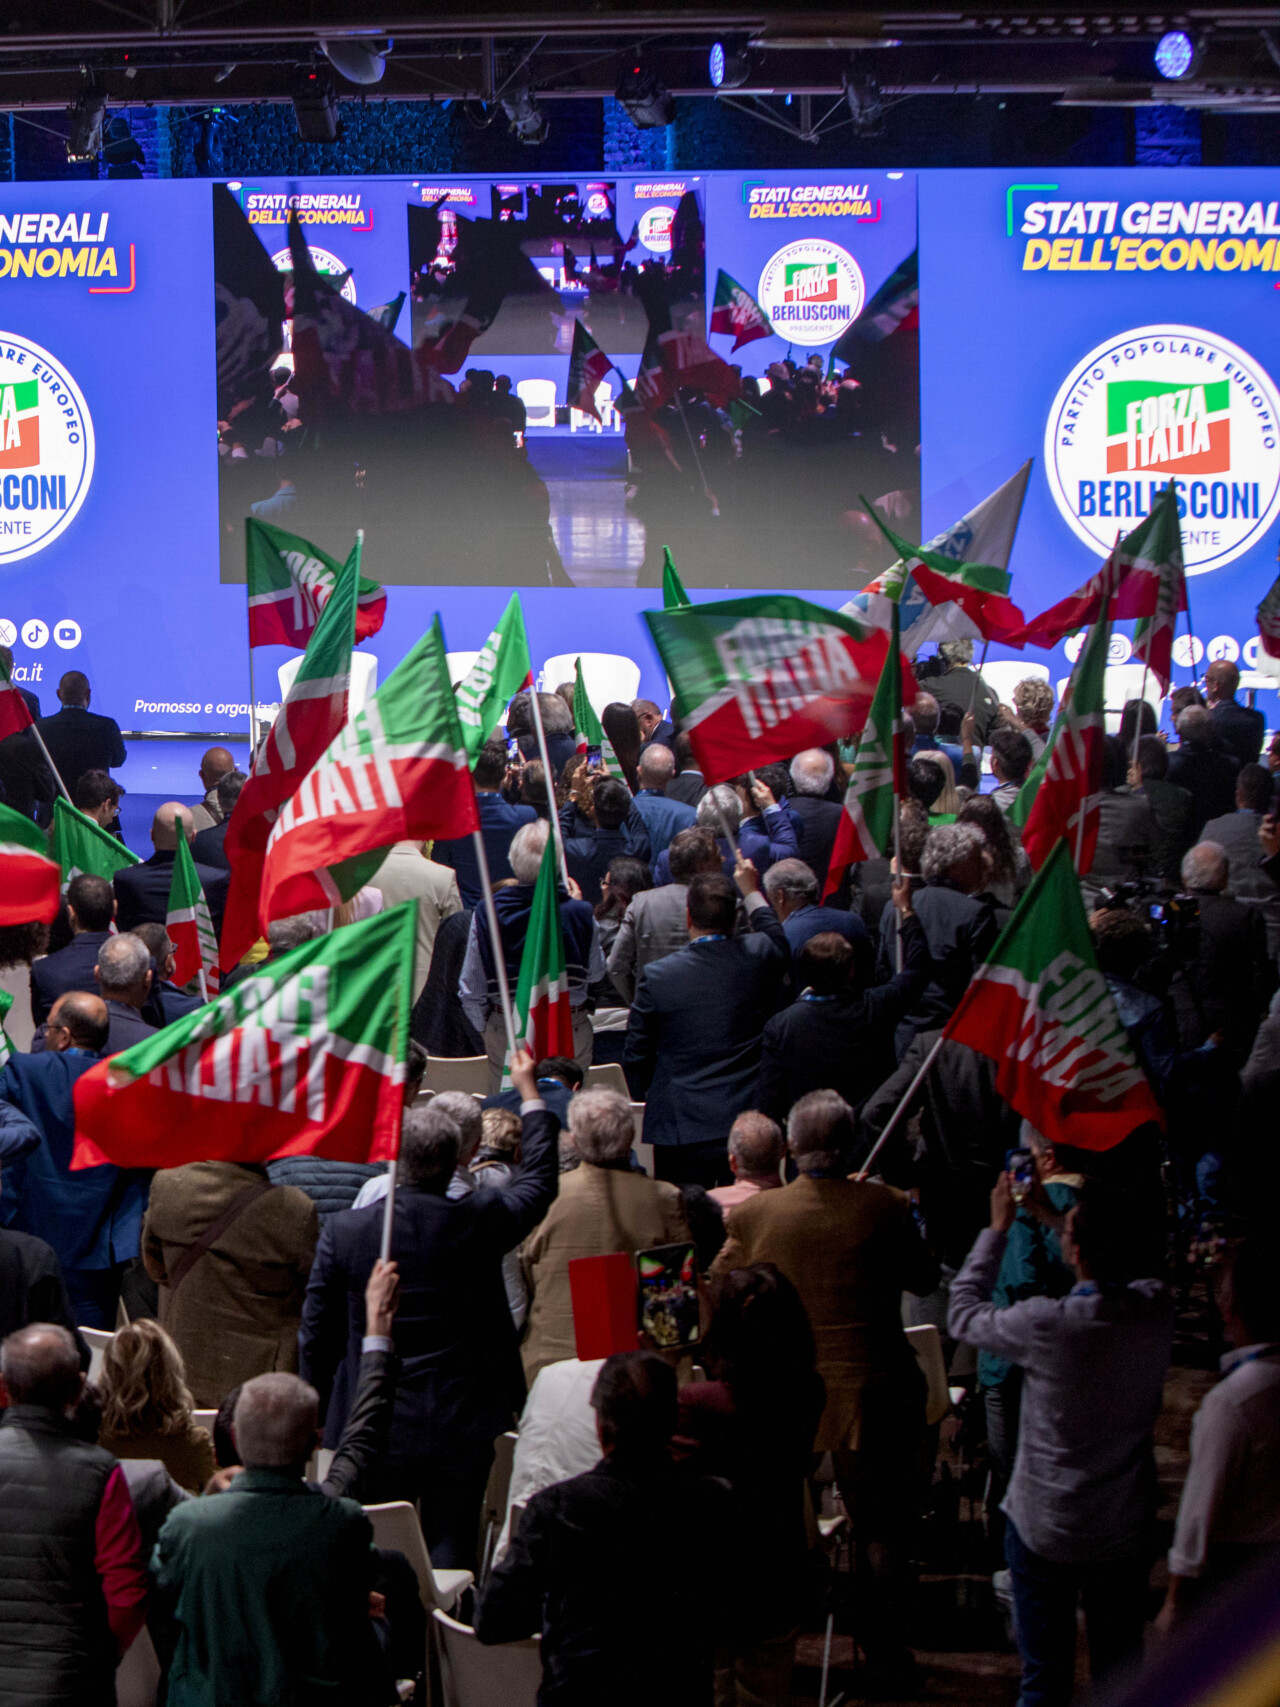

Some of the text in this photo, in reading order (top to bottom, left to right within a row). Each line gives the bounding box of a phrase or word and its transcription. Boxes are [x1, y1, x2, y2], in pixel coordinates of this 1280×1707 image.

[247, 194, 361, 209] STATI GENERALI
[749, 184, 869, 203] STATI GENERALI
[248, 209, 366, 225] DELL'CONOMIA
[749, 201, 872, 219] DELL'ECONOMIA
[1020, 201, 1280, 235] STATI GENERAL
[1022, 236, 1280, 272] DELL'ECONOMI
[772, 304, 851, 321] BERLUSCONI
[31, 362, 80, 445] EUROPEO
[1061, 341, 1276, 450] PARTITO POPOLARE EUROPEO
[1126, 384, 1207, 433] FORZA
[1127, 420, 1211, 471] ITALIA
[134, 699, 201, 714] Promosso
[204, 704, 213, 713] e
